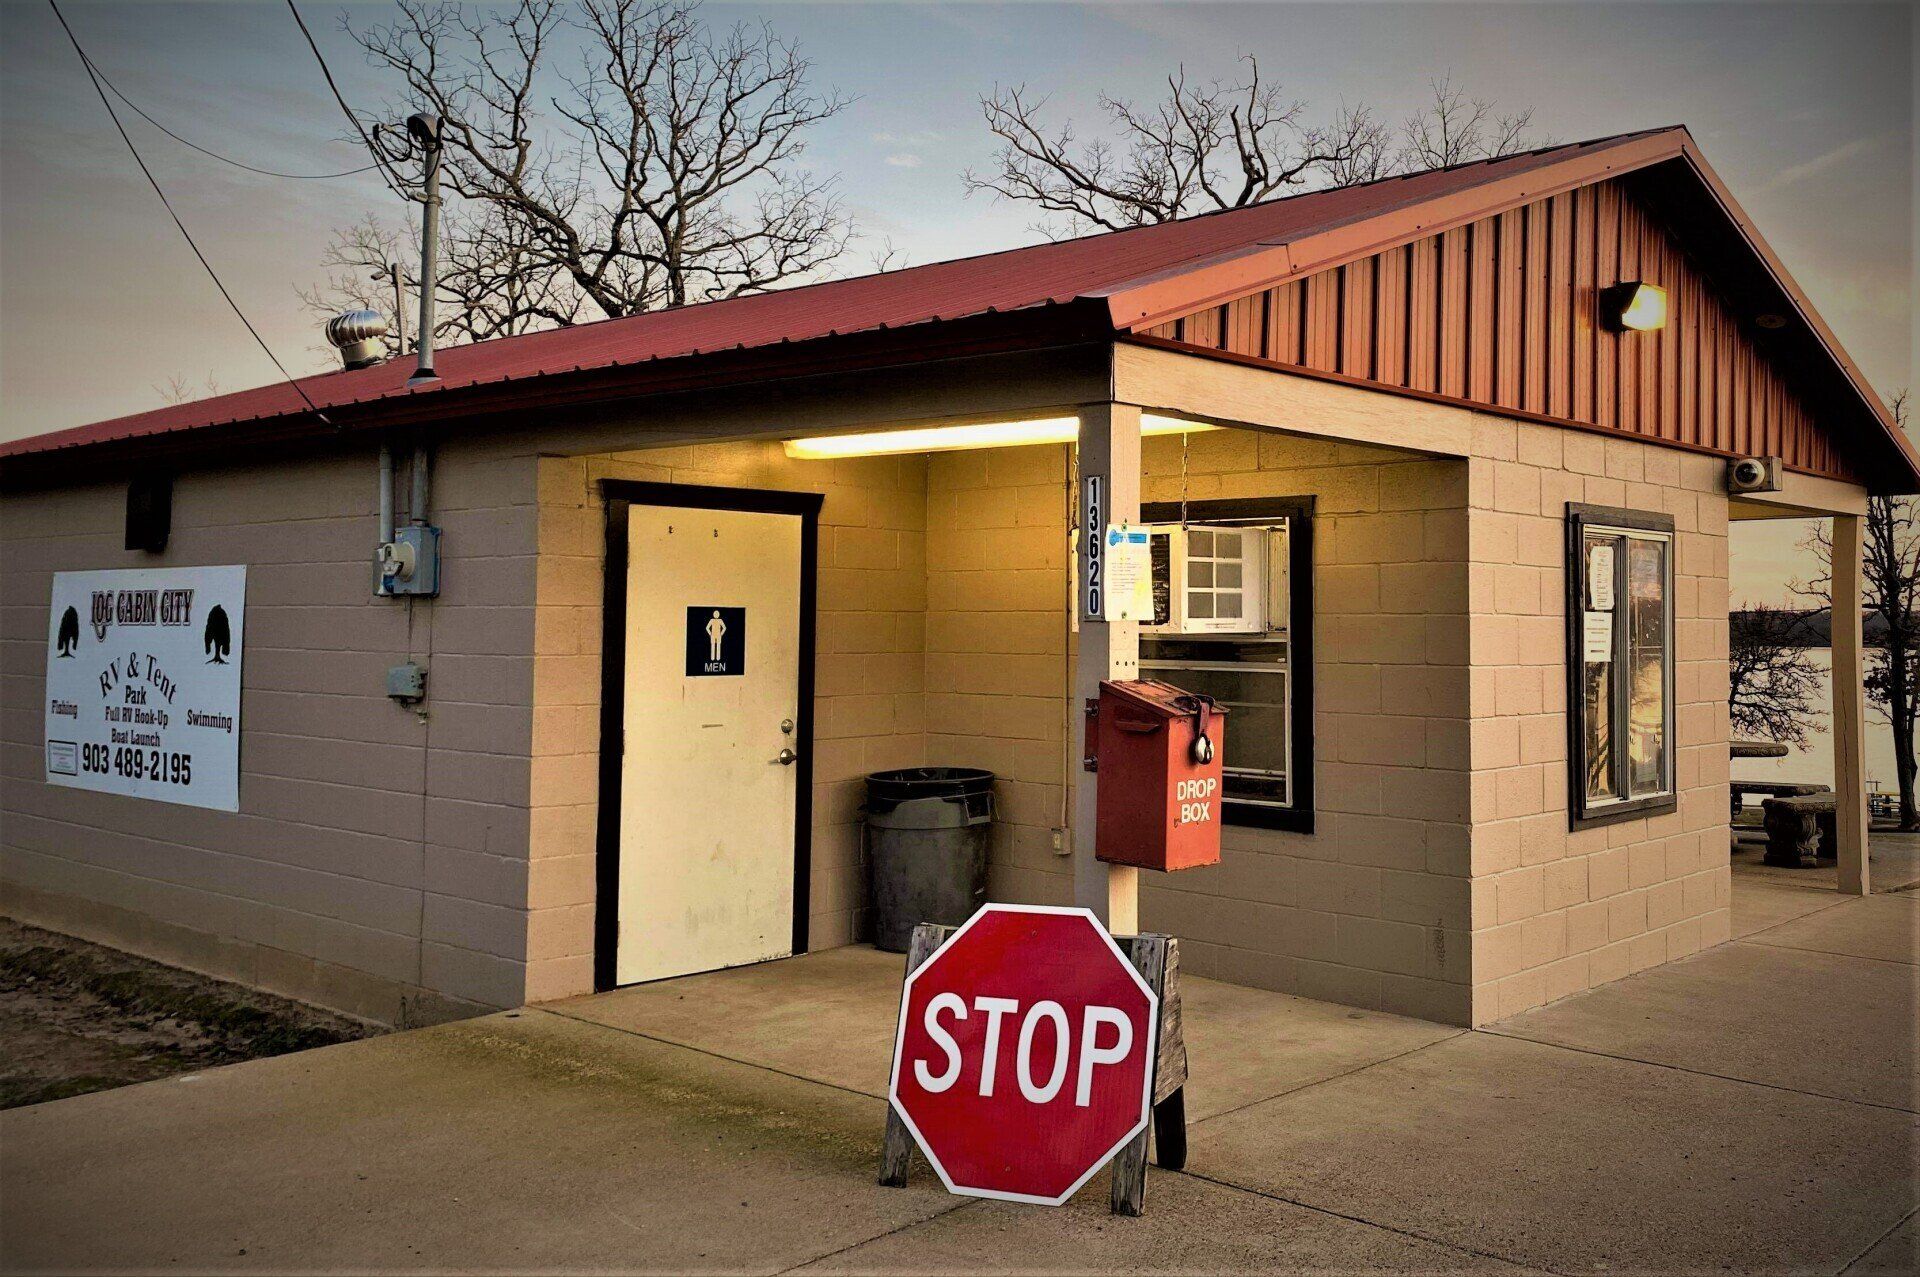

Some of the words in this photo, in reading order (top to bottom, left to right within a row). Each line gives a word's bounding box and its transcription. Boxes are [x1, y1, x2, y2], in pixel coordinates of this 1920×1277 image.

[1088, 477, 1100, 615] 13620
[117, 590, 158, 626] CABIN
[161, 589, 194, 626] CITY
[99, 657, 120, 699] RV
[127, 652, 139, 678] &
[146, 654, 177, 705] Tent
[704, 662, 726, 672] MEN
[125, 685, 147, 705] Park
[52, 699, 78, 719] Fishing
[105, 706, 120, 722] Full
[122, 706, 133, 723] RV
[134, 708, 169, 729] Hook-Up
[187, 709, 232, 733] Swimming
[111, 728, 128, 743] Boat
[131, 730, 161, 747] Launch
[82, 743, 109, 774] 903
[114, 747, 191, 785] 489-2195
[1176, 778, 1217, 801] DROP
[1181, 802, 1211, 824] BOX
[914, 992, 1134, 1107] STOP
